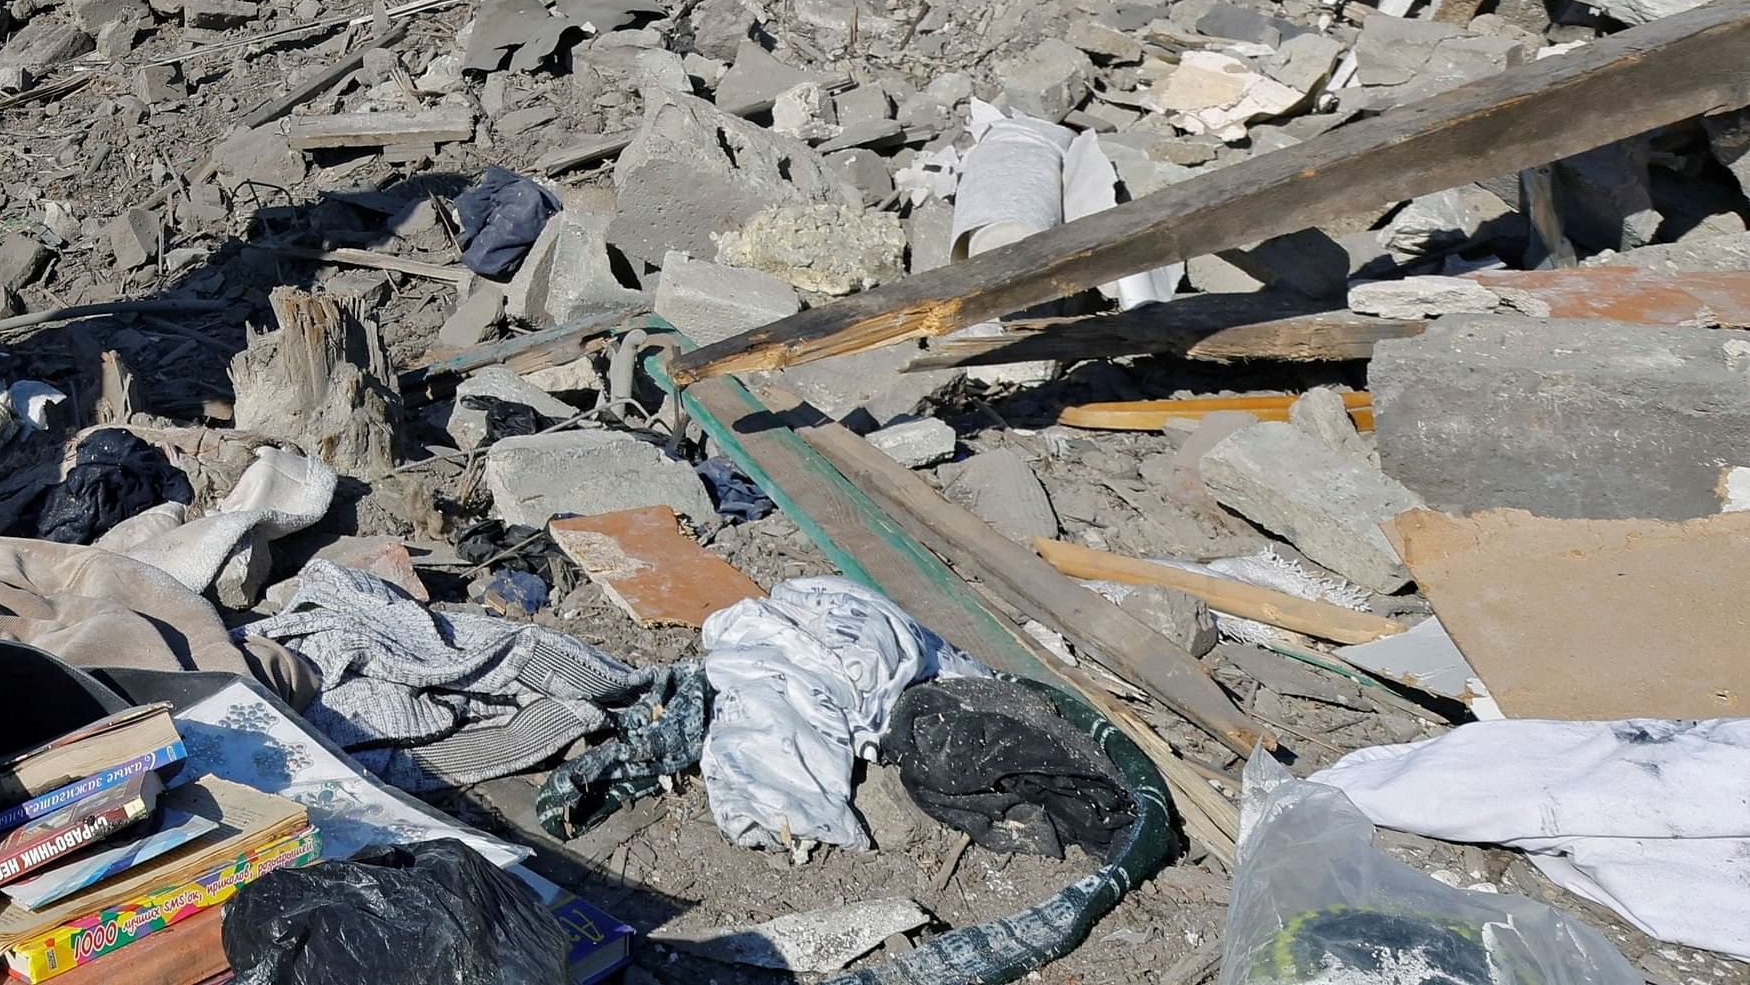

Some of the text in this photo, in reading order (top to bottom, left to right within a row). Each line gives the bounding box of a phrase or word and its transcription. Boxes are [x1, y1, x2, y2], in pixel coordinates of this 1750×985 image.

[106, 752, 157, 783] Самые
[74, 921, 117, 959] 1000
[122, 908, 160, 935] лучших
